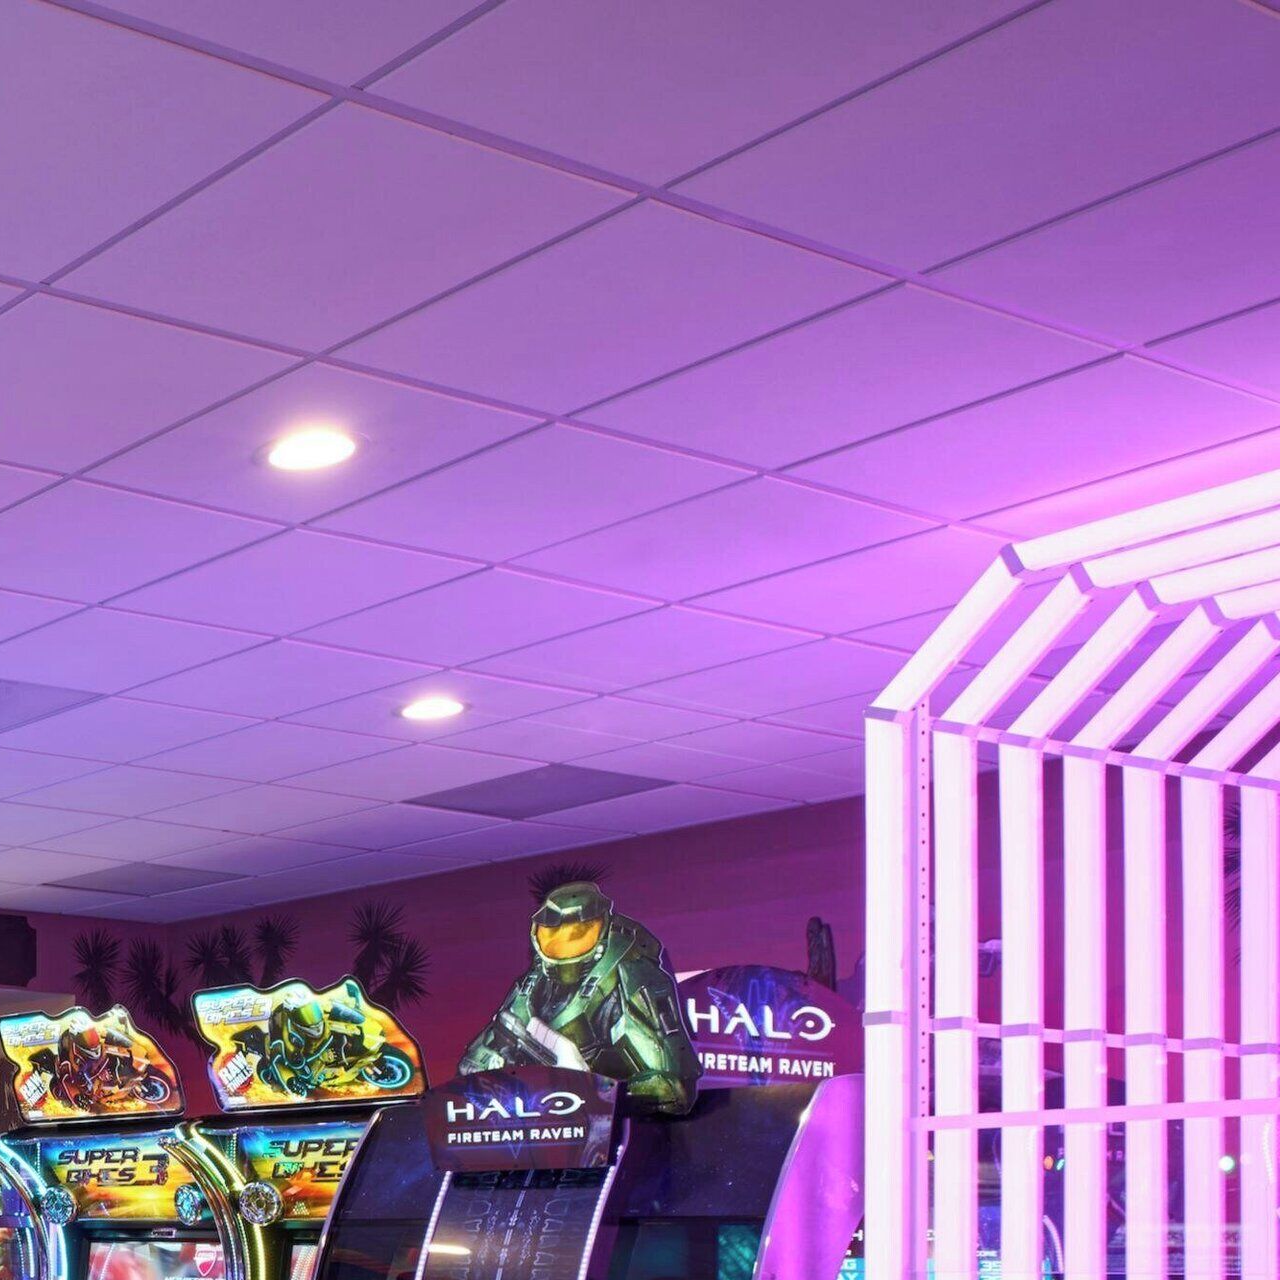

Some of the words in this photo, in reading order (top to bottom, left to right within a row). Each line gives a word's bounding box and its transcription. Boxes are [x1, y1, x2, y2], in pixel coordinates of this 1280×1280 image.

[686, 997, 836, 1042] HALO
[698, 1052, 773, 1073] IRETEAM
[778, 1057, 835, 1078] RAVEN
[446, 1091, 586, 1123] HALO
[447, 1130, 524, 1144] FIRETEAM
[530, 1126, 584, 1140] RAVEN
[58, 1147, 140, 1167] SUPER
